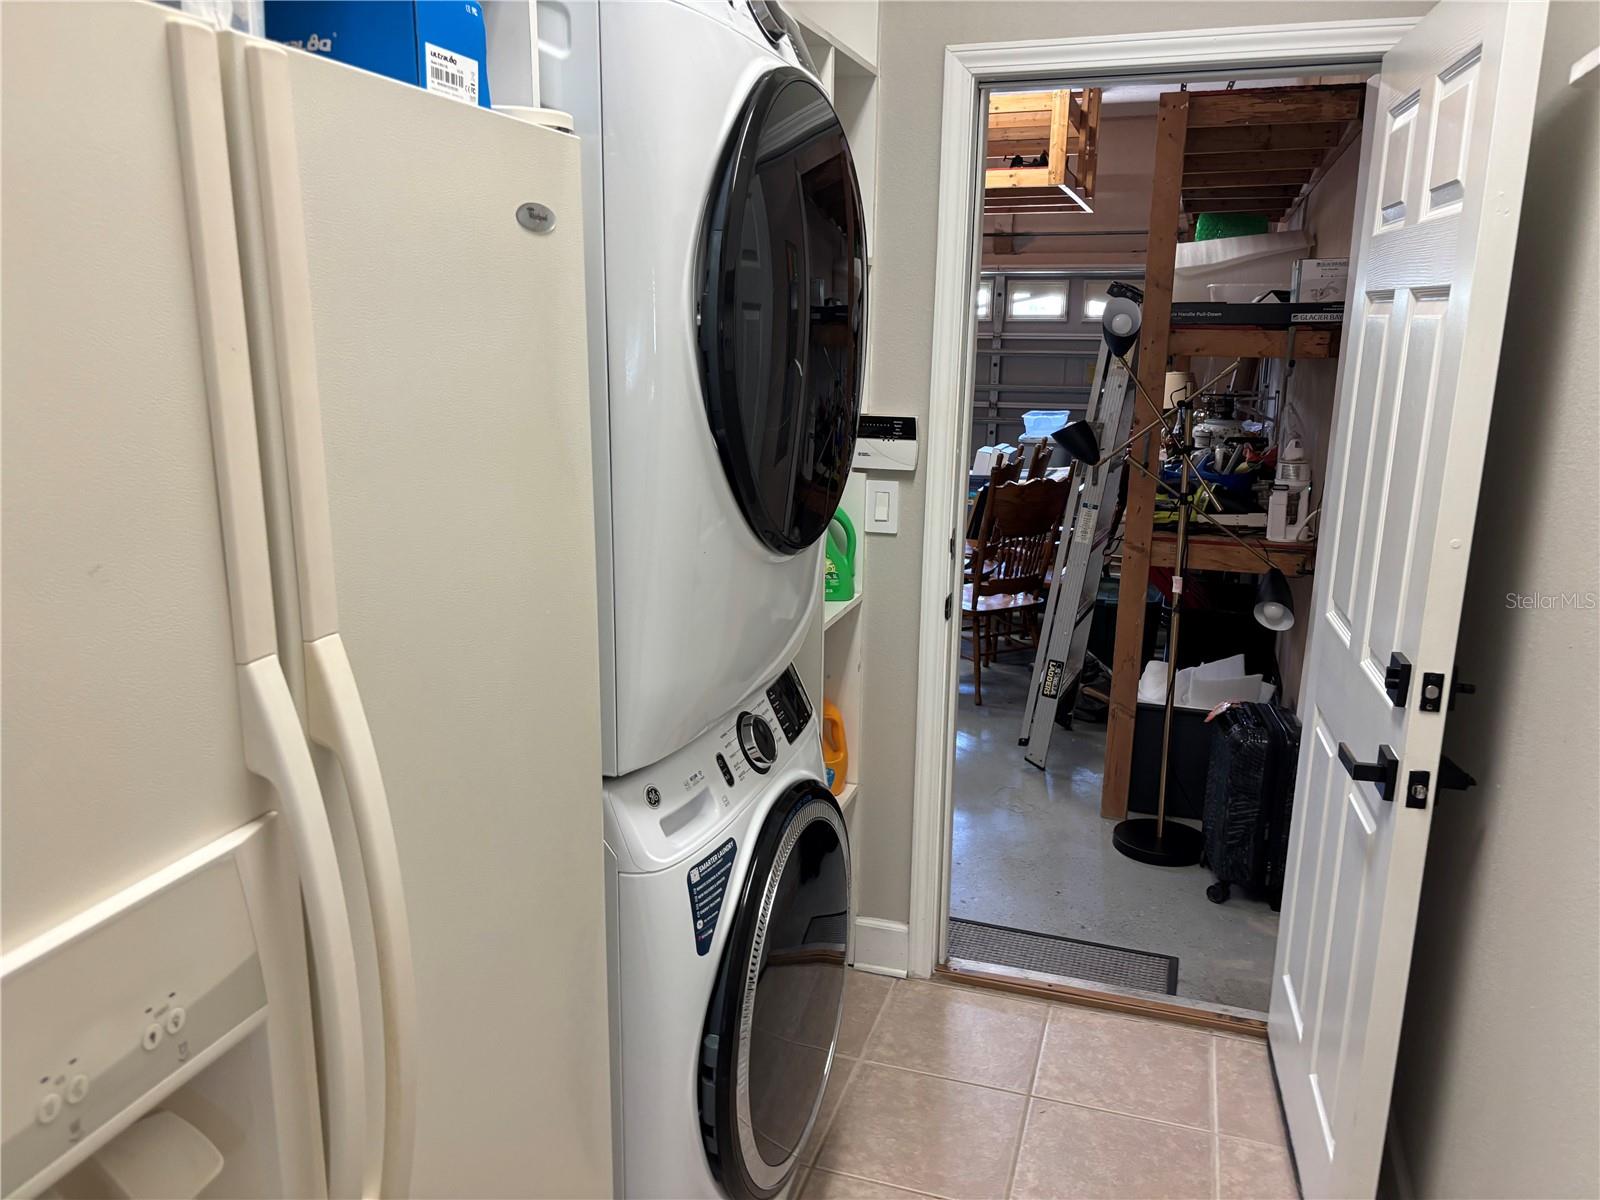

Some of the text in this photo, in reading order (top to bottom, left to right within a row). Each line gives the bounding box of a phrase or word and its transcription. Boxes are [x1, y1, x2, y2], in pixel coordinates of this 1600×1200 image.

[1044, 661, 1057, 697] LADDERS
[698, 853, 718, 873] SMARTER
[717, 840, 734, 859] LAUNDRY
